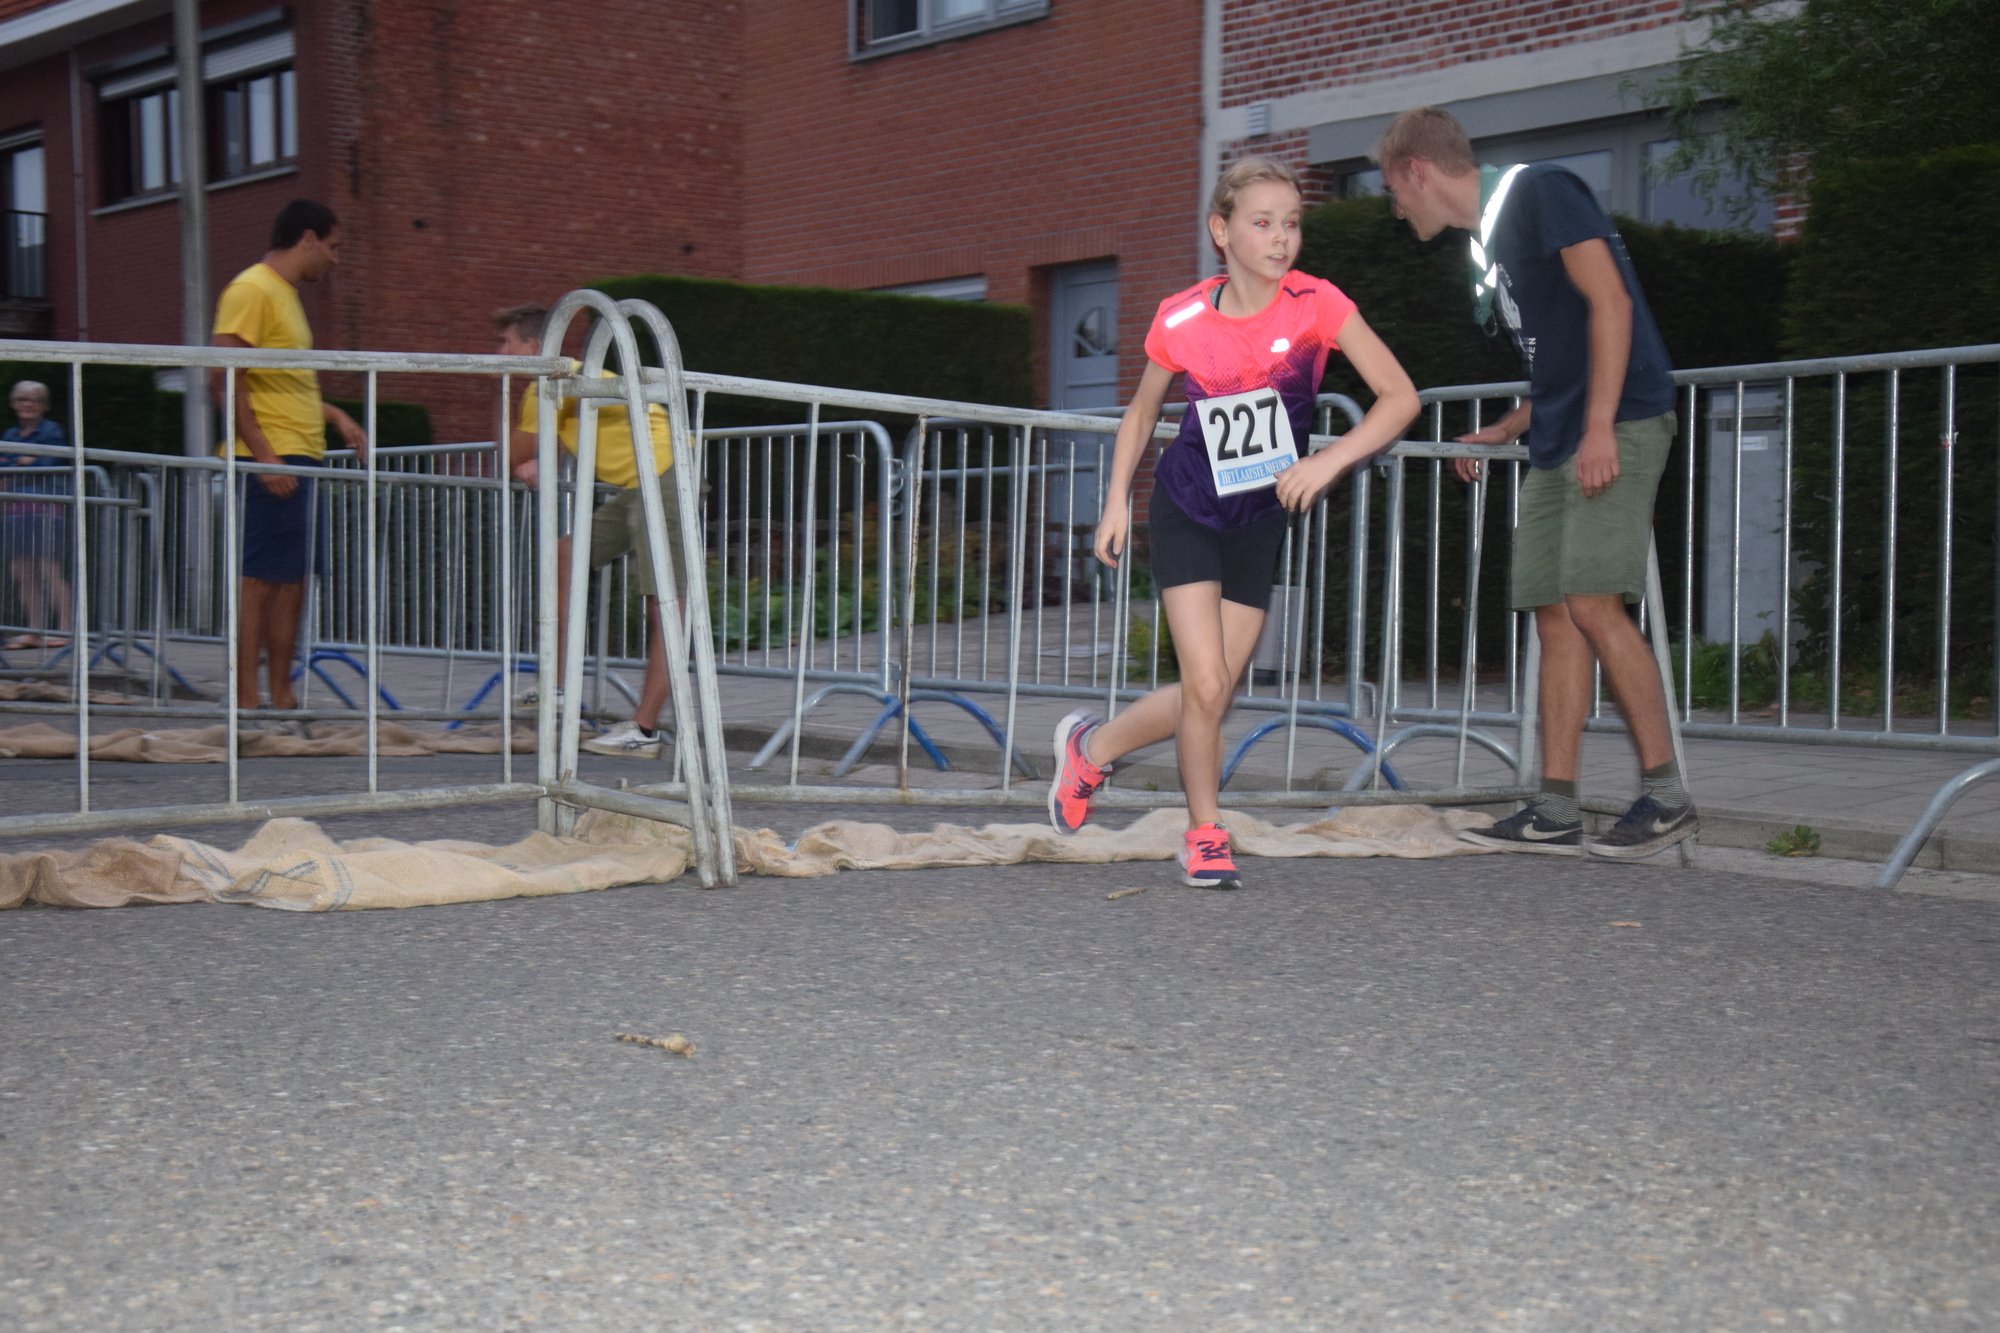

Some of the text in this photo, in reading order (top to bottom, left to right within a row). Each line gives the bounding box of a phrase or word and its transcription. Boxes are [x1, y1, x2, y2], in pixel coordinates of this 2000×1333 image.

[1209, 395, 1278, 461] 227
[1221, 469, 1236, 485] HET
[1236, 465, 1265, 482] LAATSTE
